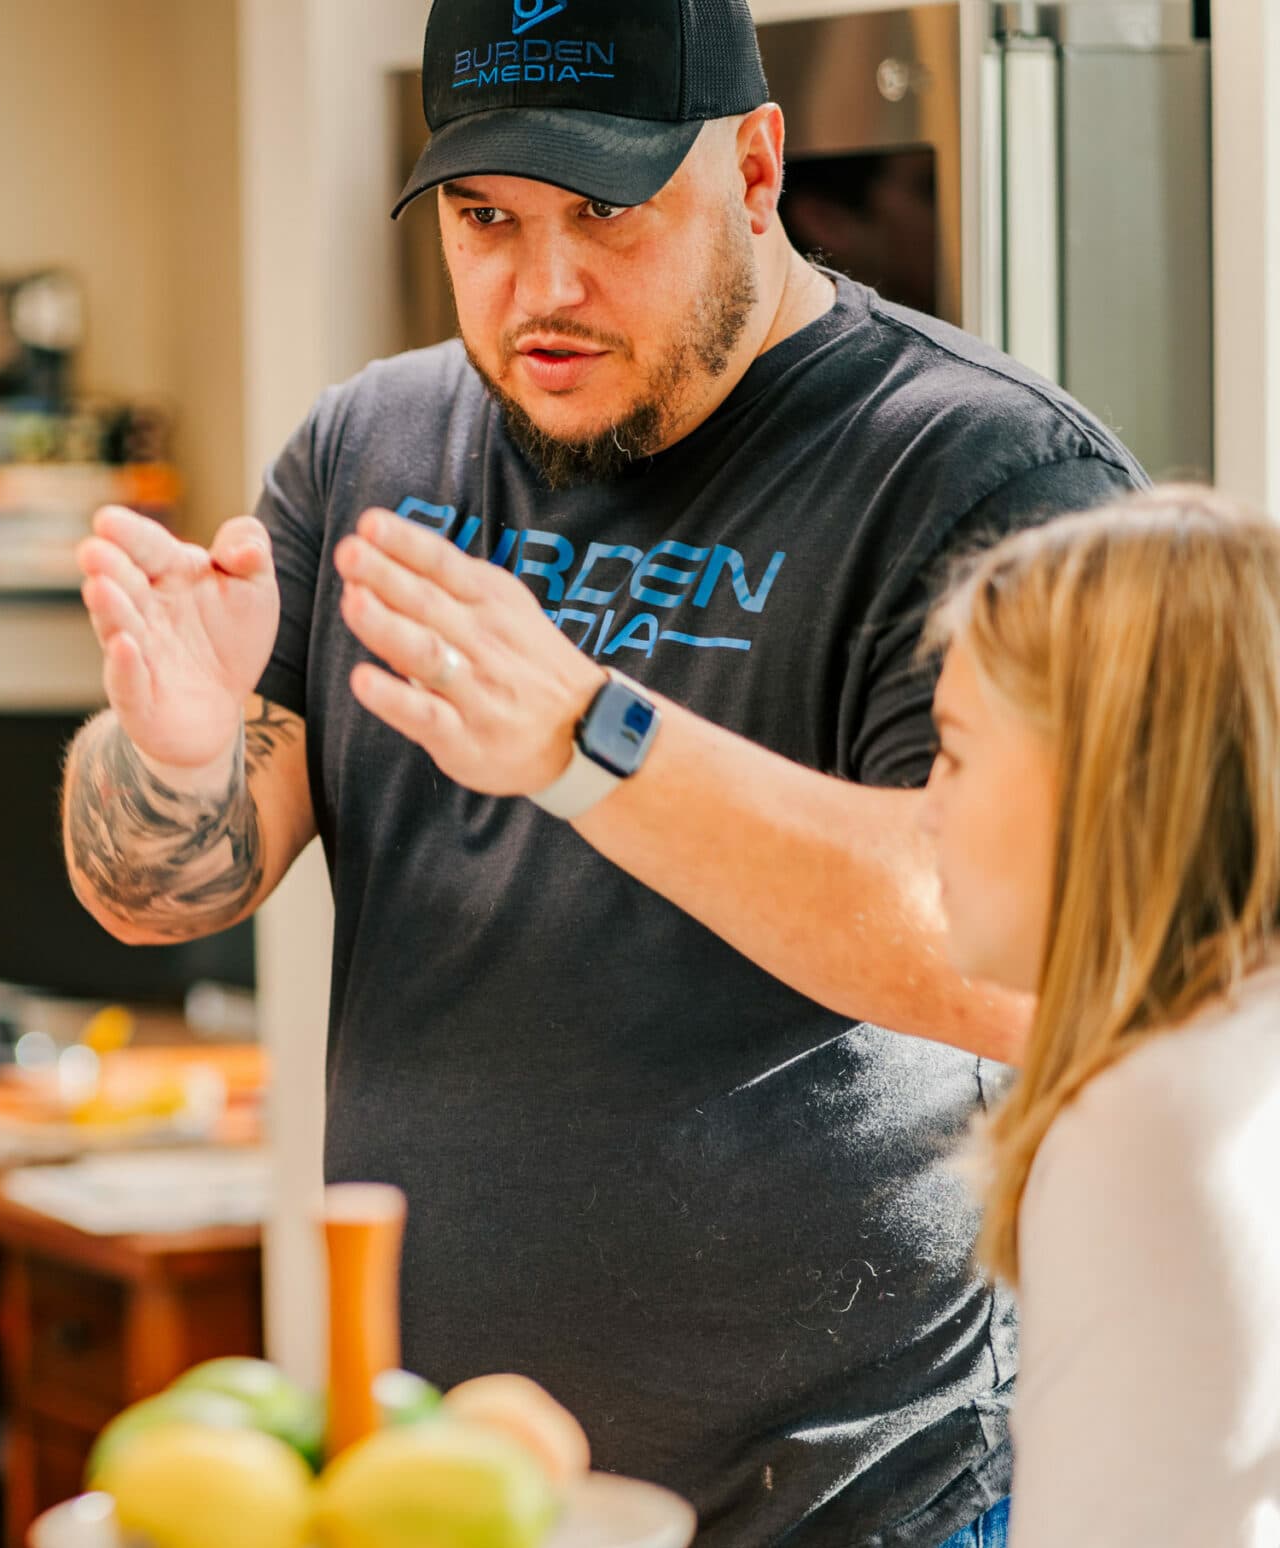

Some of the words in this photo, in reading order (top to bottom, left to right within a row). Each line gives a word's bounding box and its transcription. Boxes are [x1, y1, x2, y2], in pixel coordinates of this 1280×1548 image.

[454, 39, 615, 75] BURDEN
[477, 63, 581, 88] MEDIA
[542, 607, 659, 659] DIA
